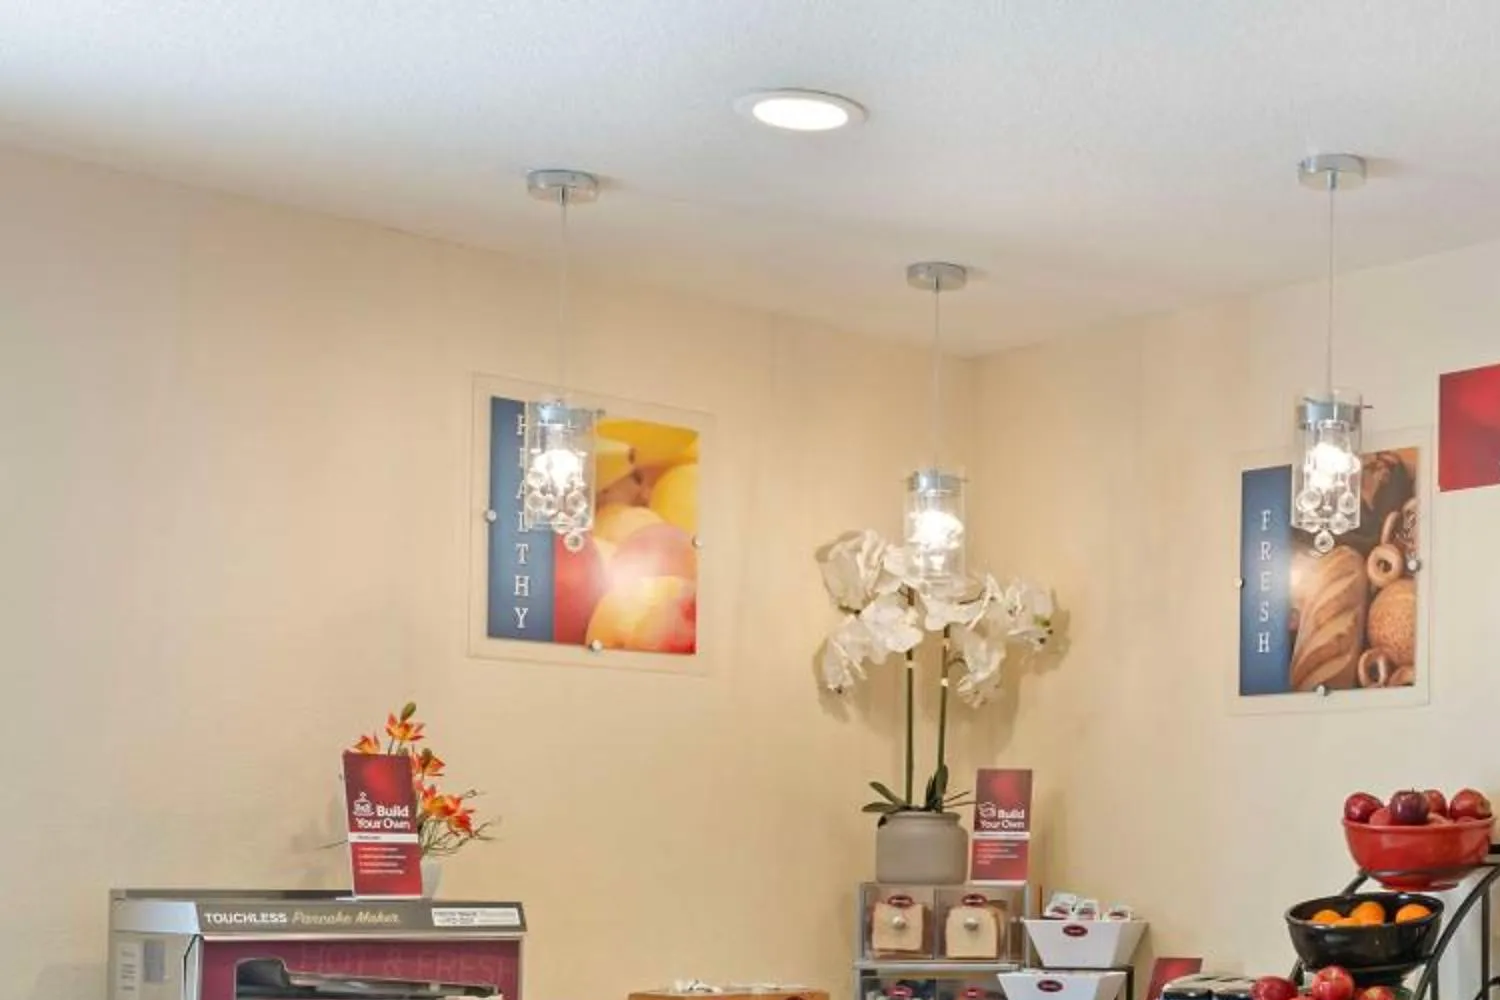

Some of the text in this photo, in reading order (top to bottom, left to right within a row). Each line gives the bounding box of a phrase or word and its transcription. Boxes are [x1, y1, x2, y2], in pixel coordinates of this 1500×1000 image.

[1257, 508, 1272, 654] FRESH
[376, 805, 410, 817] Build
[997, 809, 1025, 819] Build
[355, 817, 411, 830] Your Own
[980, 819, 1025, 829] Your Own
[204, 912, 288, 924] TOUCHLESS
[354, 911, 399, 924] Maker
